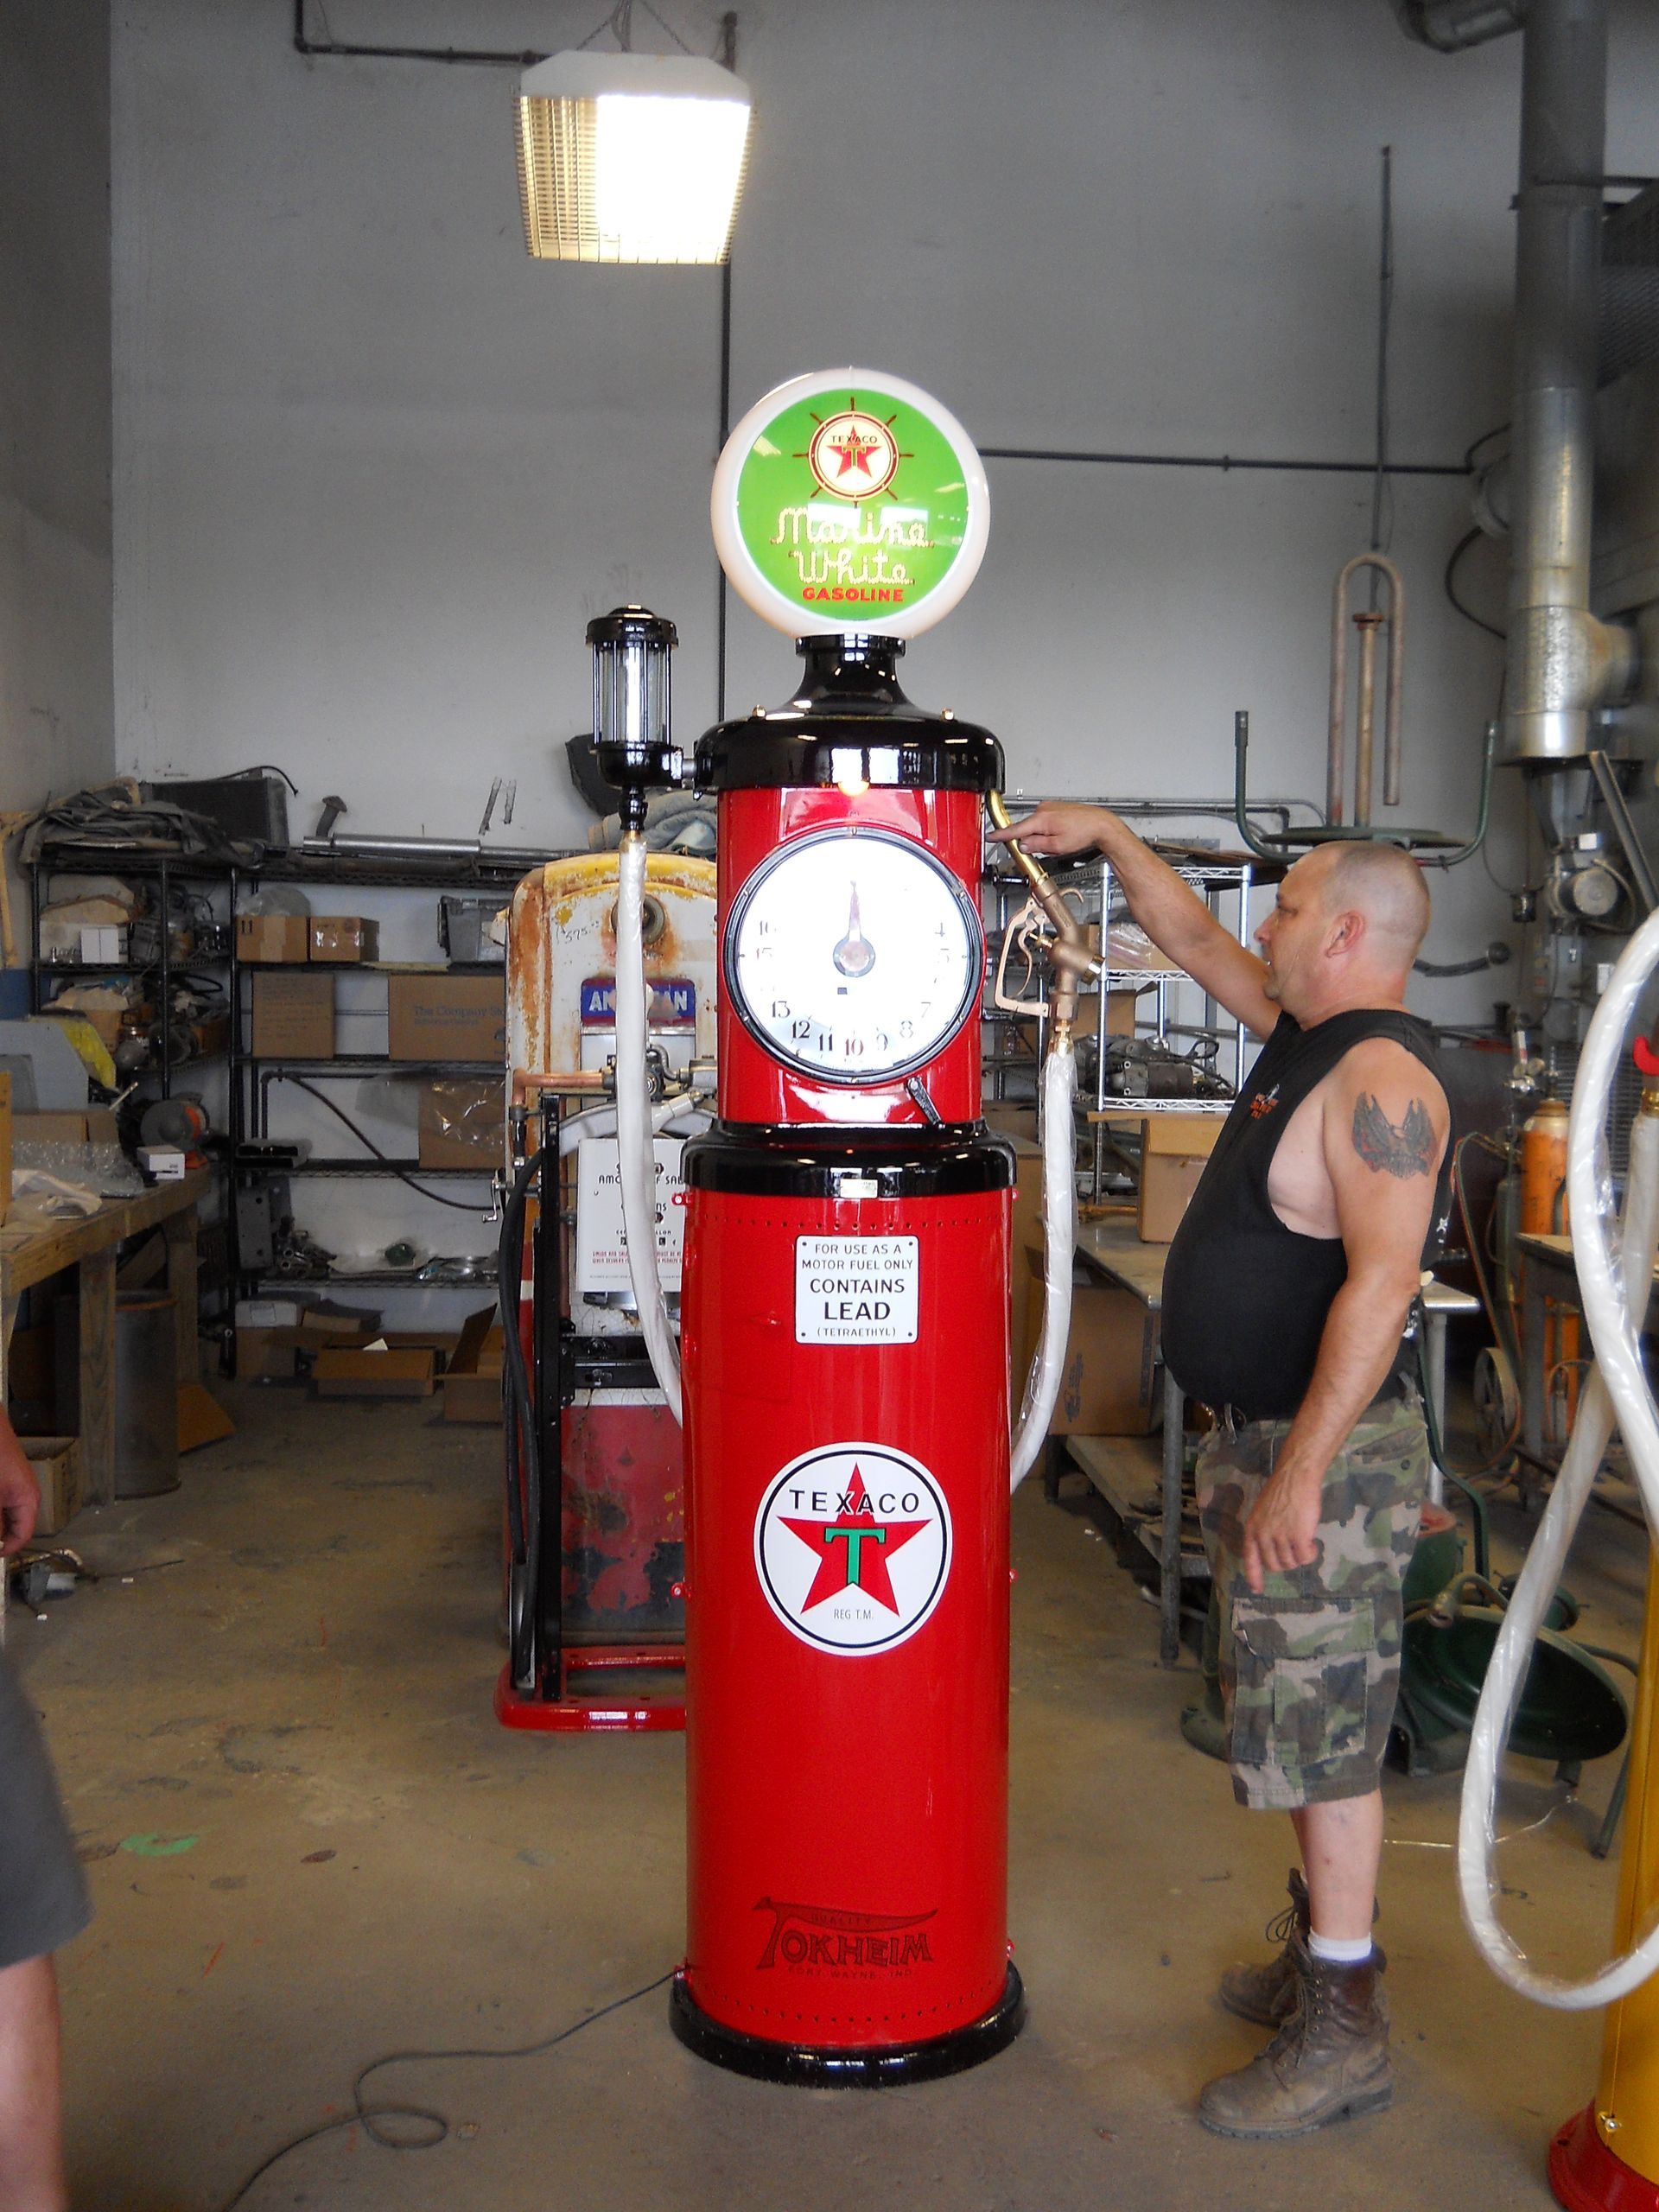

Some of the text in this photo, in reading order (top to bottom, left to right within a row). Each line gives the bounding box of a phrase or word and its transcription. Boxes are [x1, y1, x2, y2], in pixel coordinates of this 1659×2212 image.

[830, 435, 878, 444] TEXACO
[788, 548, 915, 586] White
[801, 586, 905, 602] GASOLINE
[771, 1001, 791, 1018] 13
[791, 1020, 810, 1039] 12
[899, 1020, 914, 1039] 8
[818, 1033, 834, 1052] 11
[845, 1039, 864, 1057] 10
[876, 1033, 889, 1052] 9
[665, 1174, 684, 1185] SAL
[815, 1243, 901, 1255] FOR USE AS A
[802, 1259, 913, 1269] MOTOR FUEL ONLY
[810, 1278, 905, 1294] CONTAINS
[824, 1301, 891, 1320] LEAD
[817, 1327, 896, 1338] (TETRAETHYL)
[789, 1489, 919, 1514] TEXACO
[833, 1609, 851, 1620] REG
[752, 1896, 938, 1971] TOKHEIM
